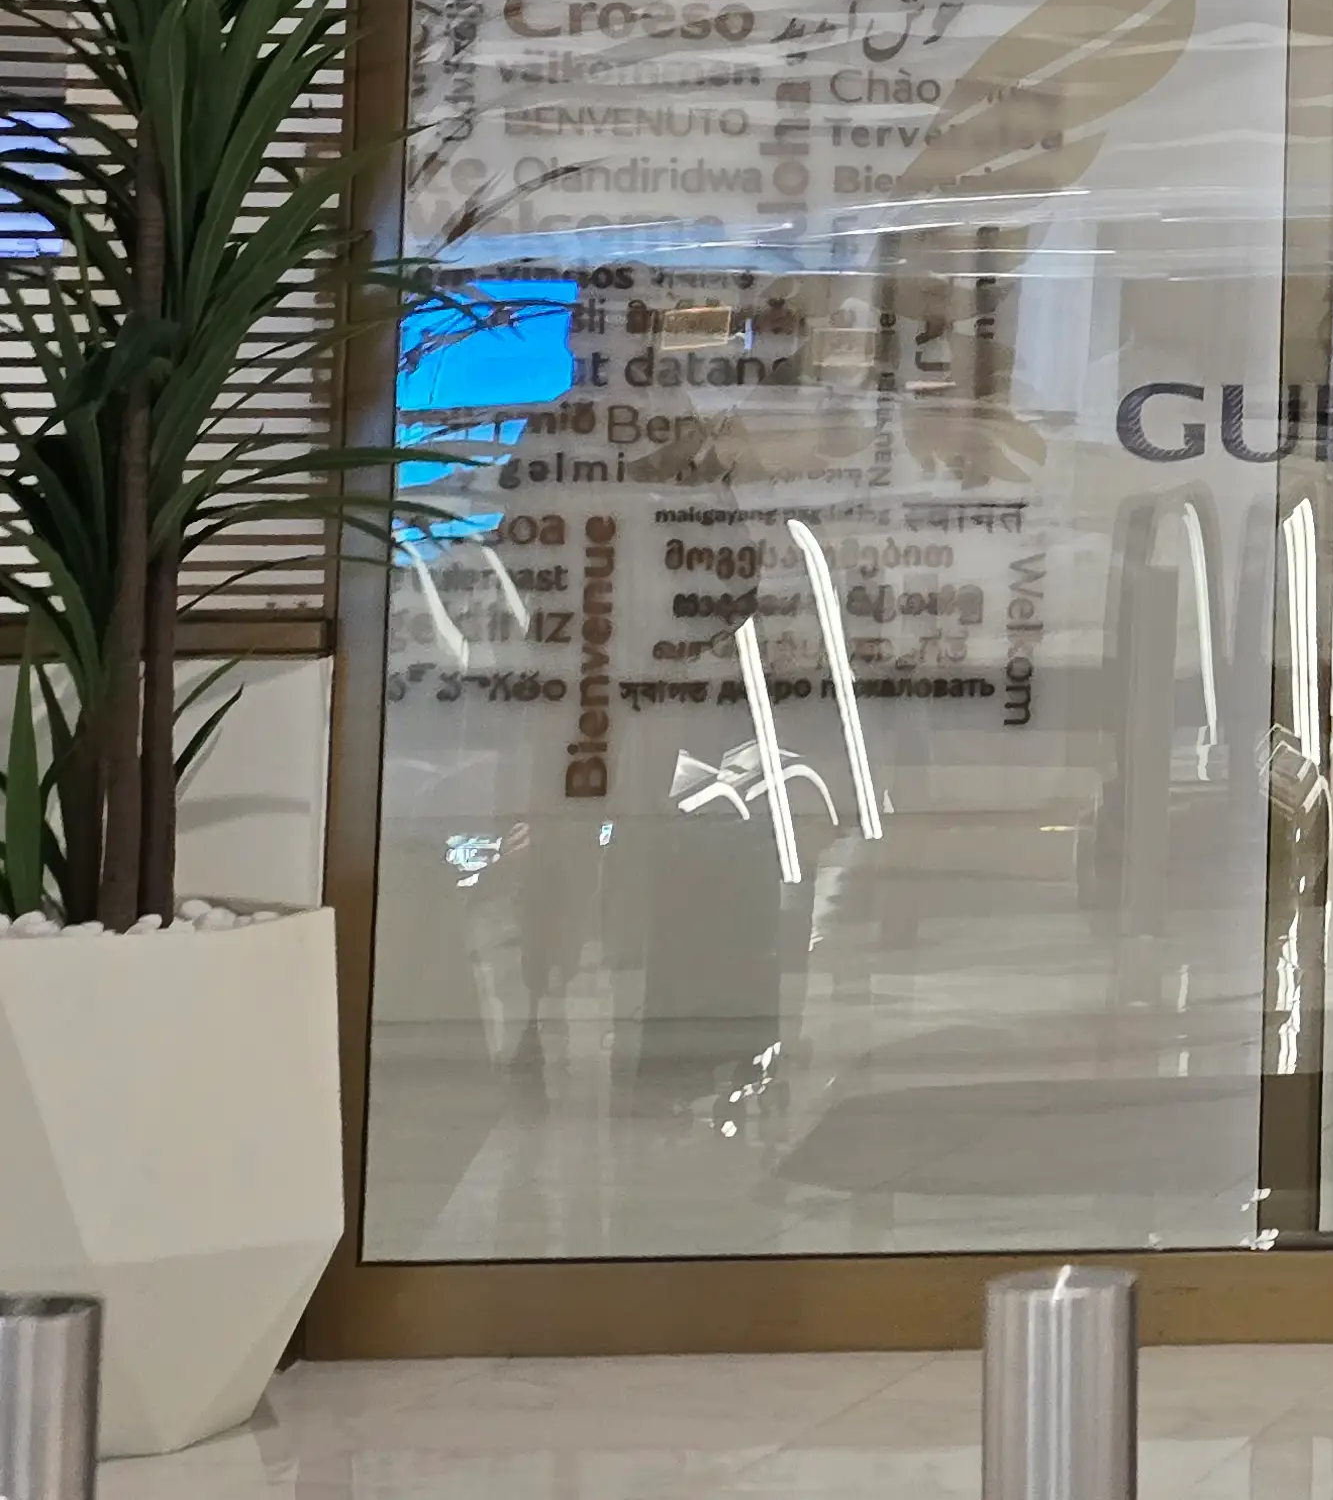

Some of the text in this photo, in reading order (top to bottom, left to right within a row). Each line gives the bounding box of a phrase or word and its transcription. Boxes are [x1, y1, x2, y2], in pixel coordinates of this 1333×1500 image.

[829, 68, 941, 104] Chào
[504, 106, 750, 138] BENVENUTO
[565, 512, 617, 798] Bienvenue
[1003, 552, 1048, 726] Welkom
[717, 678, 996, 705] дро пжаловать
